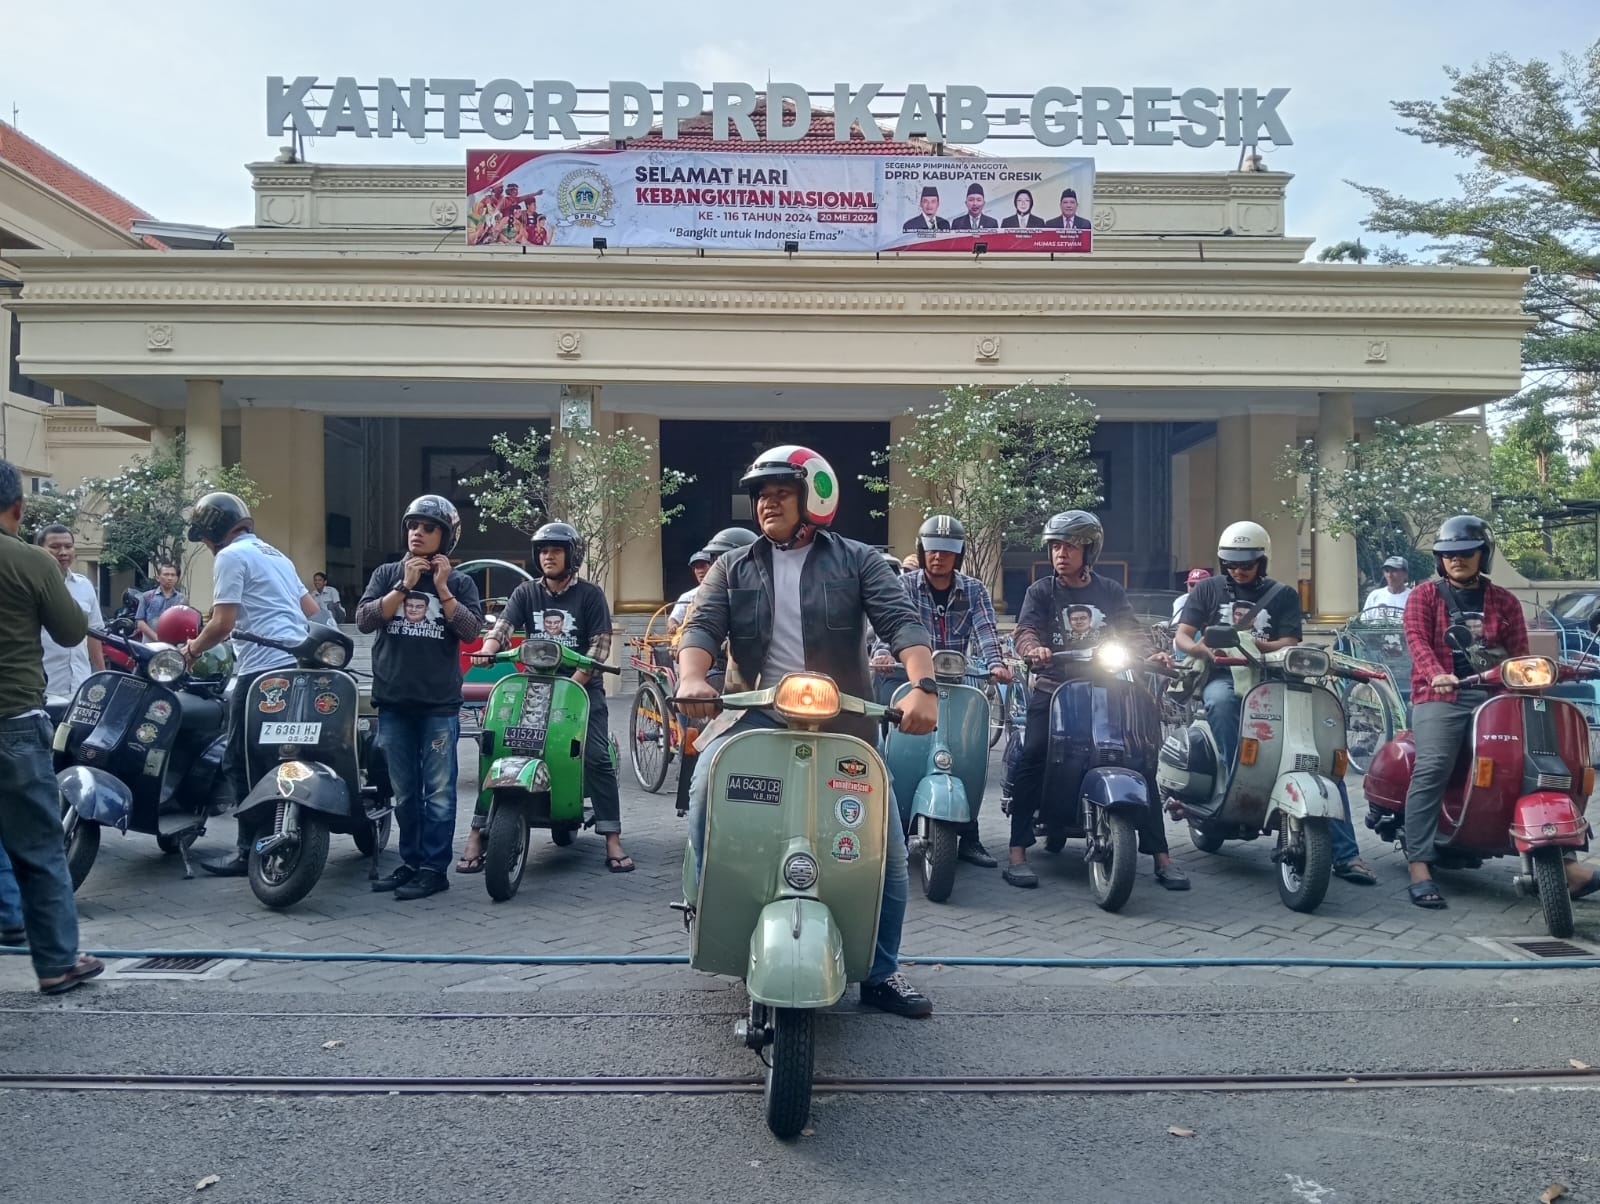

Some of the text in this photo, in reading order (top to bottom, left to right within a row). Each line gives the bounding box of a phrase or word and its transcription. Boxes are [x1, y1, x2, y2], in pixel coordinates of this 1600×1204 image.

[267, 76, 580, 140] KANTOR
[609, 81, 811, 141] DPRD
[1030, 86, 1293, 147] GRESIK
[635, 166, 788, 185] SELAMAT HARI
[885, 171, 1042, 181] DPRD KABUPATEN GRESIK
[636, 187, 877, 209] KEBANGKITAN NASIONAL
[574, 212, 597, 220] DPRD
[698, 211, 713, 221] KE
[724, 212, 739, 222] 116
[742, 212, 782, 222] TAHUN
[785, 213, 812, 223] 2024
[820, 213, 874, 222] 20 MEI 2024
[720, 229, 751, 238] untuk
[754, 229, 806, 240] Indonesia
[402, 626, 445, 640] SYAHRUL
[264, 725, 317, 735] Z 6361 HJ
[1482, 734, 1519, 742] vespa
[730, 777, 780, 793] AA 6430 CB
